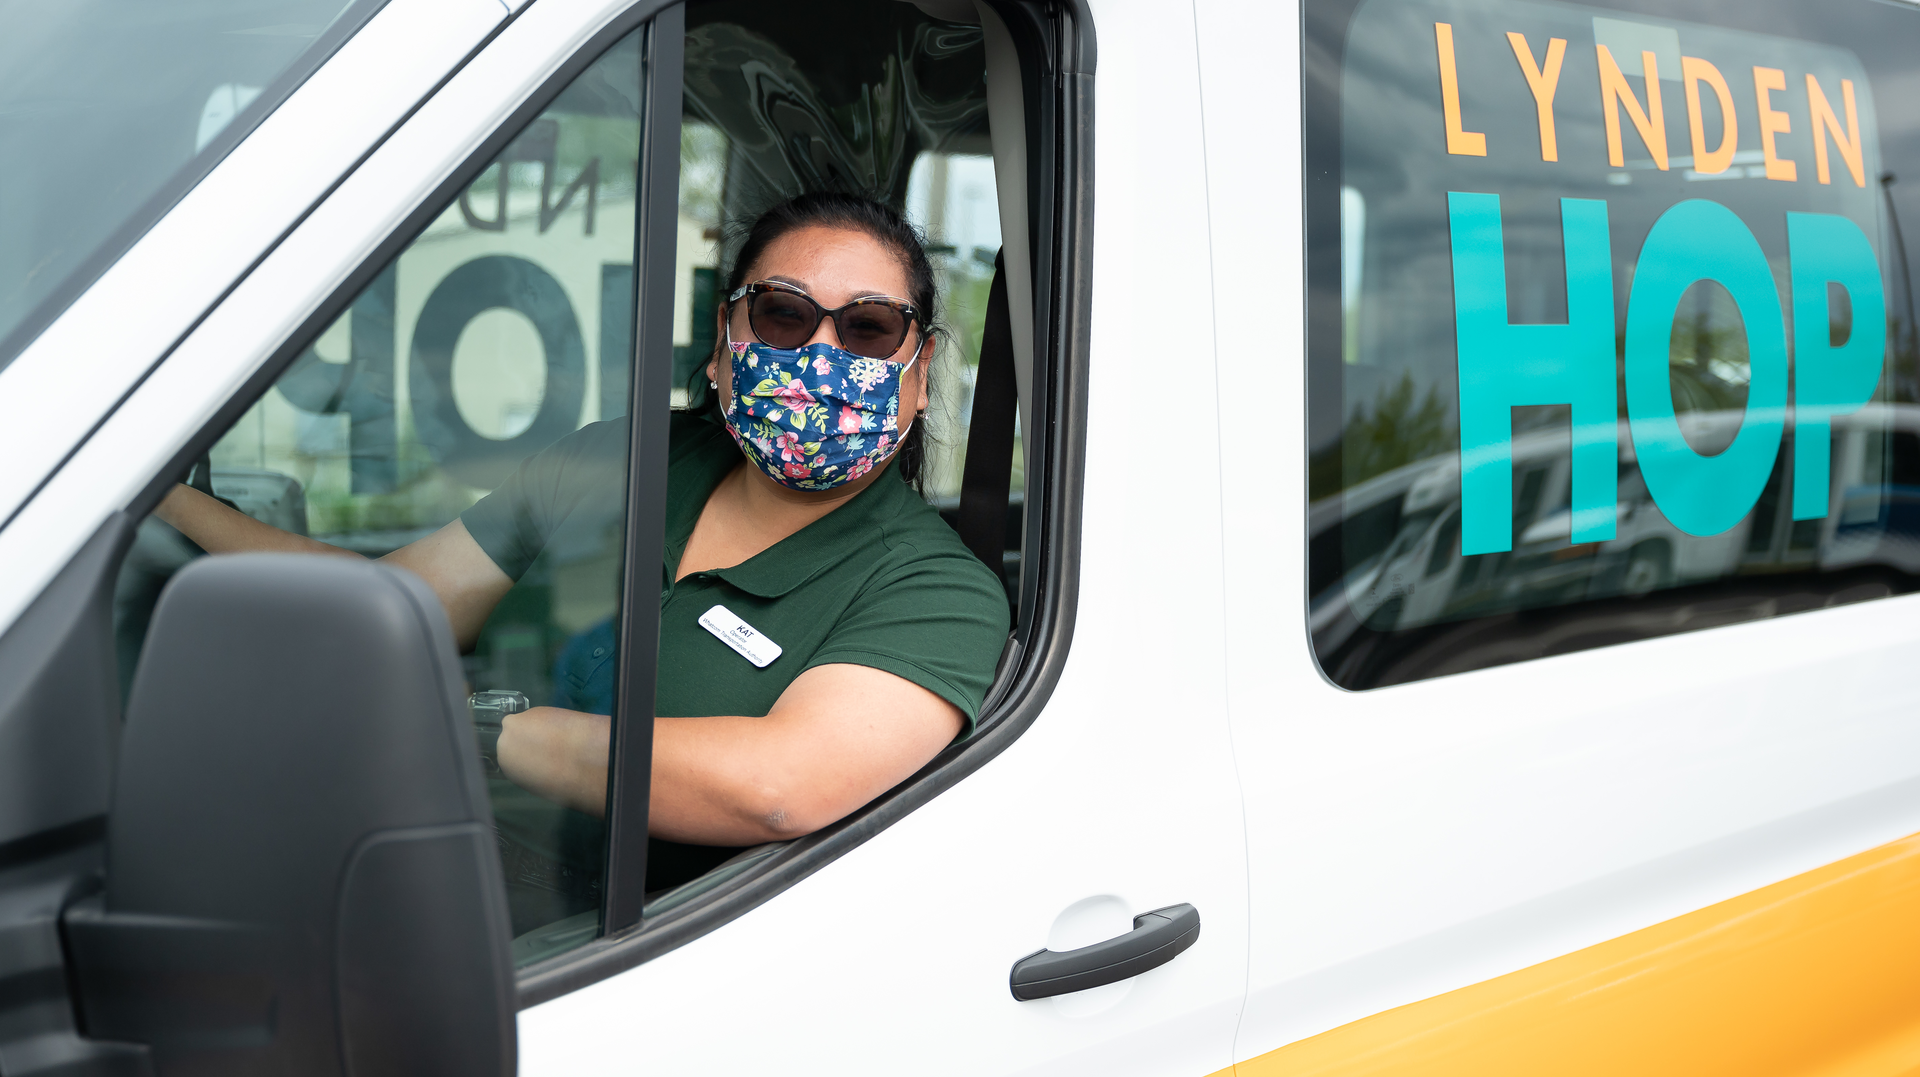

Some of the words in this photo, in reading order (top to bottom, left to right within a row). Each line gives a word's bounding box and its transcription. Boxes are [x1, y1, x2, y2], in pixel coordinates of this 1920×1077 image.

[1435, 22, 1866, 188] LYNDEN
[1447, 191, 1887, 556] HOP
[703, 618, 720, 632] Whatcom
[721, 631, 747, 651] Transportation
[747, 650, 762, 664] Authority
[730, 630, 747, 643] Operator
[736, 625, 755, 638] KAT
